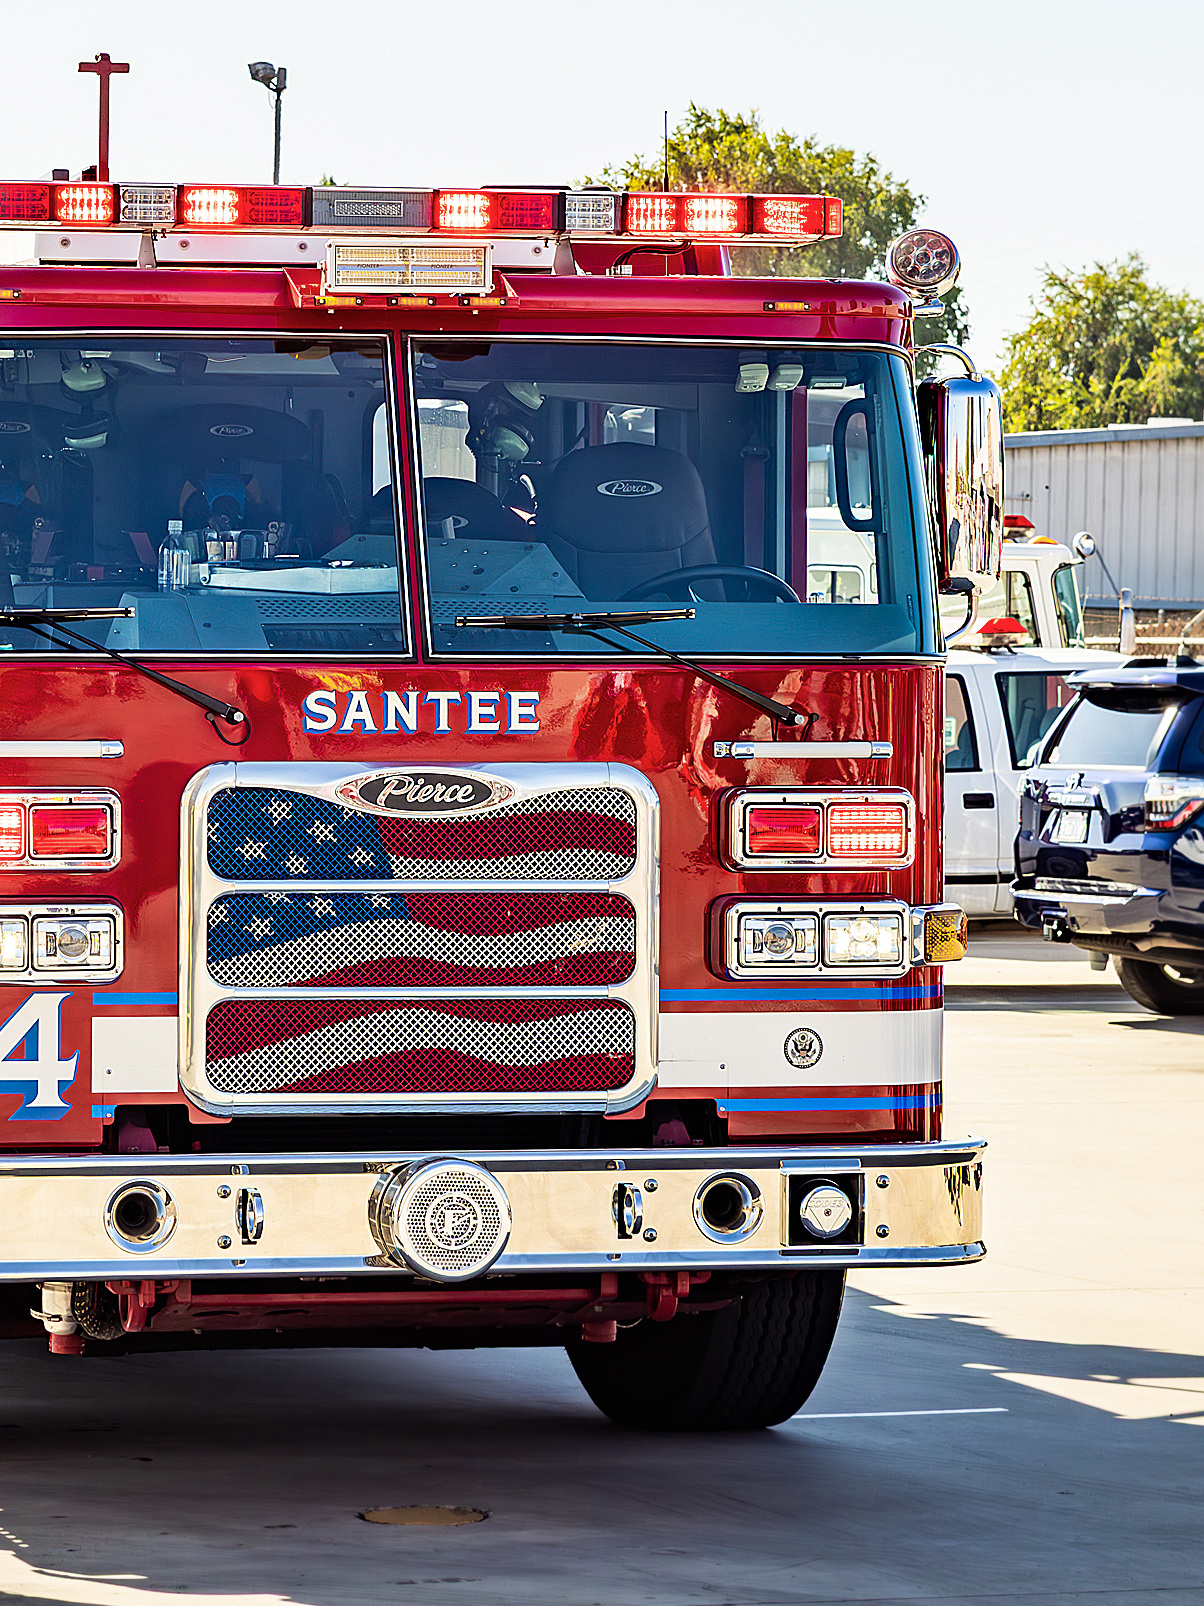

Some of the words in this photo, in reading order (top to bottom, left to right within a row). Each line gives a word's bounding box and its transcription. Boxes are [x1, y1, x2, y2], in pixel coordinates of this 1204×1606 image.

[611, 482, 648, 493] Pierce
[302, 689, 541, 735] SANTEE
[377, 775, 476, 806] Pierce
